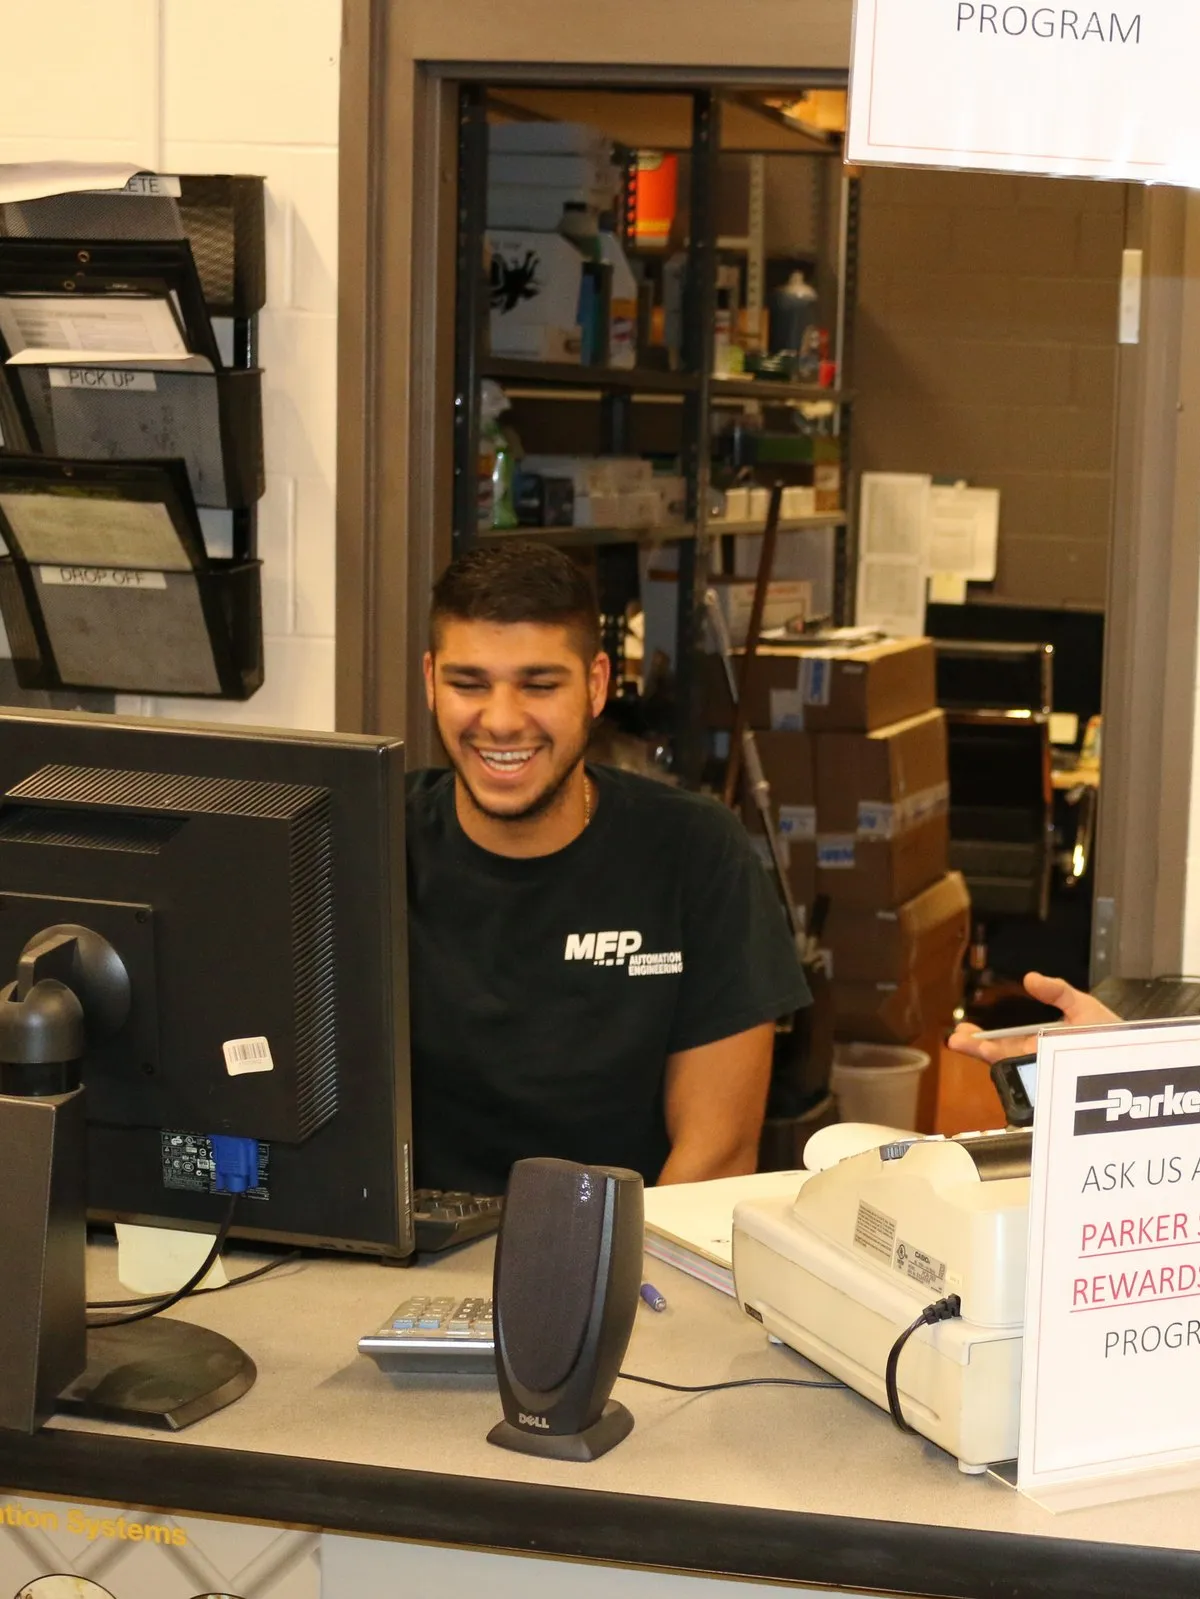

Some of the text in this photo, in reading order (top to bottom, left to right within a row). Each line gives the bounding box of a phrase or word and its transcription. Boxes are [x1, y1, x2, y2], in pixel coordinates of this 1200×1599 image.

[956, 2, 1142, 44] PROGRAM
[68, 368, 135, 387] PICK UP
[60, 567, 107, 583] DROP
[564, 930, 643, 962] MFP
[629, 951, 682, 965] AUTOMATION
[628, 962, 684, 976] ENGINEERING
[1081, 1161, 1136, 1193] ASK
[1146, 1155, 1183, 1186] US
[1081, 1212, 1189, 1252] PARKER
[518, 1411, 550, 1429] DELL
[0, 1503, 187, 1546] tion Systems
